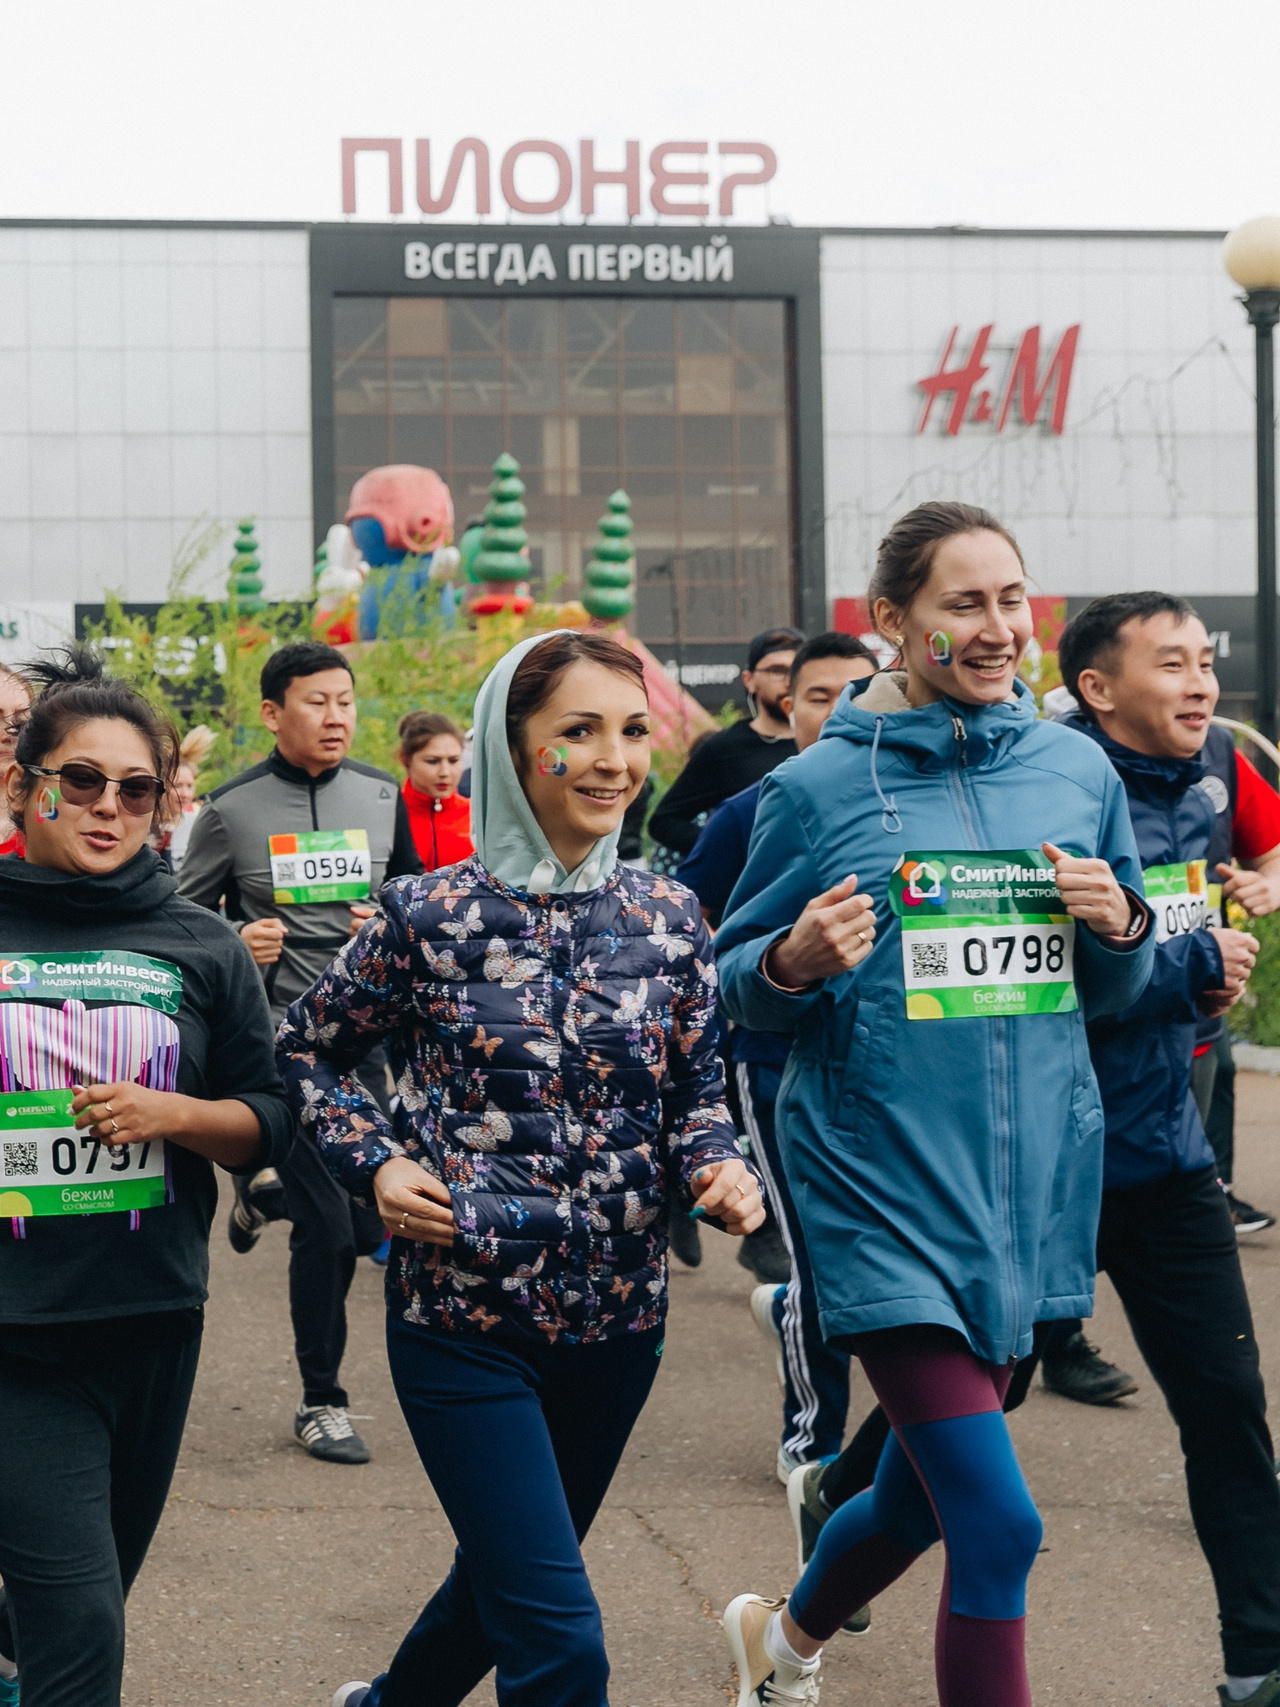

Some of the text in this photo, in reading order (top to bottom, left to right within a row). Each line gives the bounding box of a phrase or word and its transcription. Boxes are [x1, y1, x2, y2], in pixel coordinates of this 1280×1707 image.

[341, 136, 778, 216] ПИОНЕР
[404, 234, 735, 286] ВСЕГДА ПЕРВЫЙ
[916, 323, 1082, 437] H&M
[304, 857, 363, 879] 0594
[950, 864, 1056, 883] СмитИнве
[963, 934, 1065, 976] 0798
[41, 961, 170, 985] СмитИнвест
[42, 977, 100, 988] НАДЕЖНЫЙ
[973, 988, 1027, 1004] бежим
[61, 1188, 114, 1202] бежим
